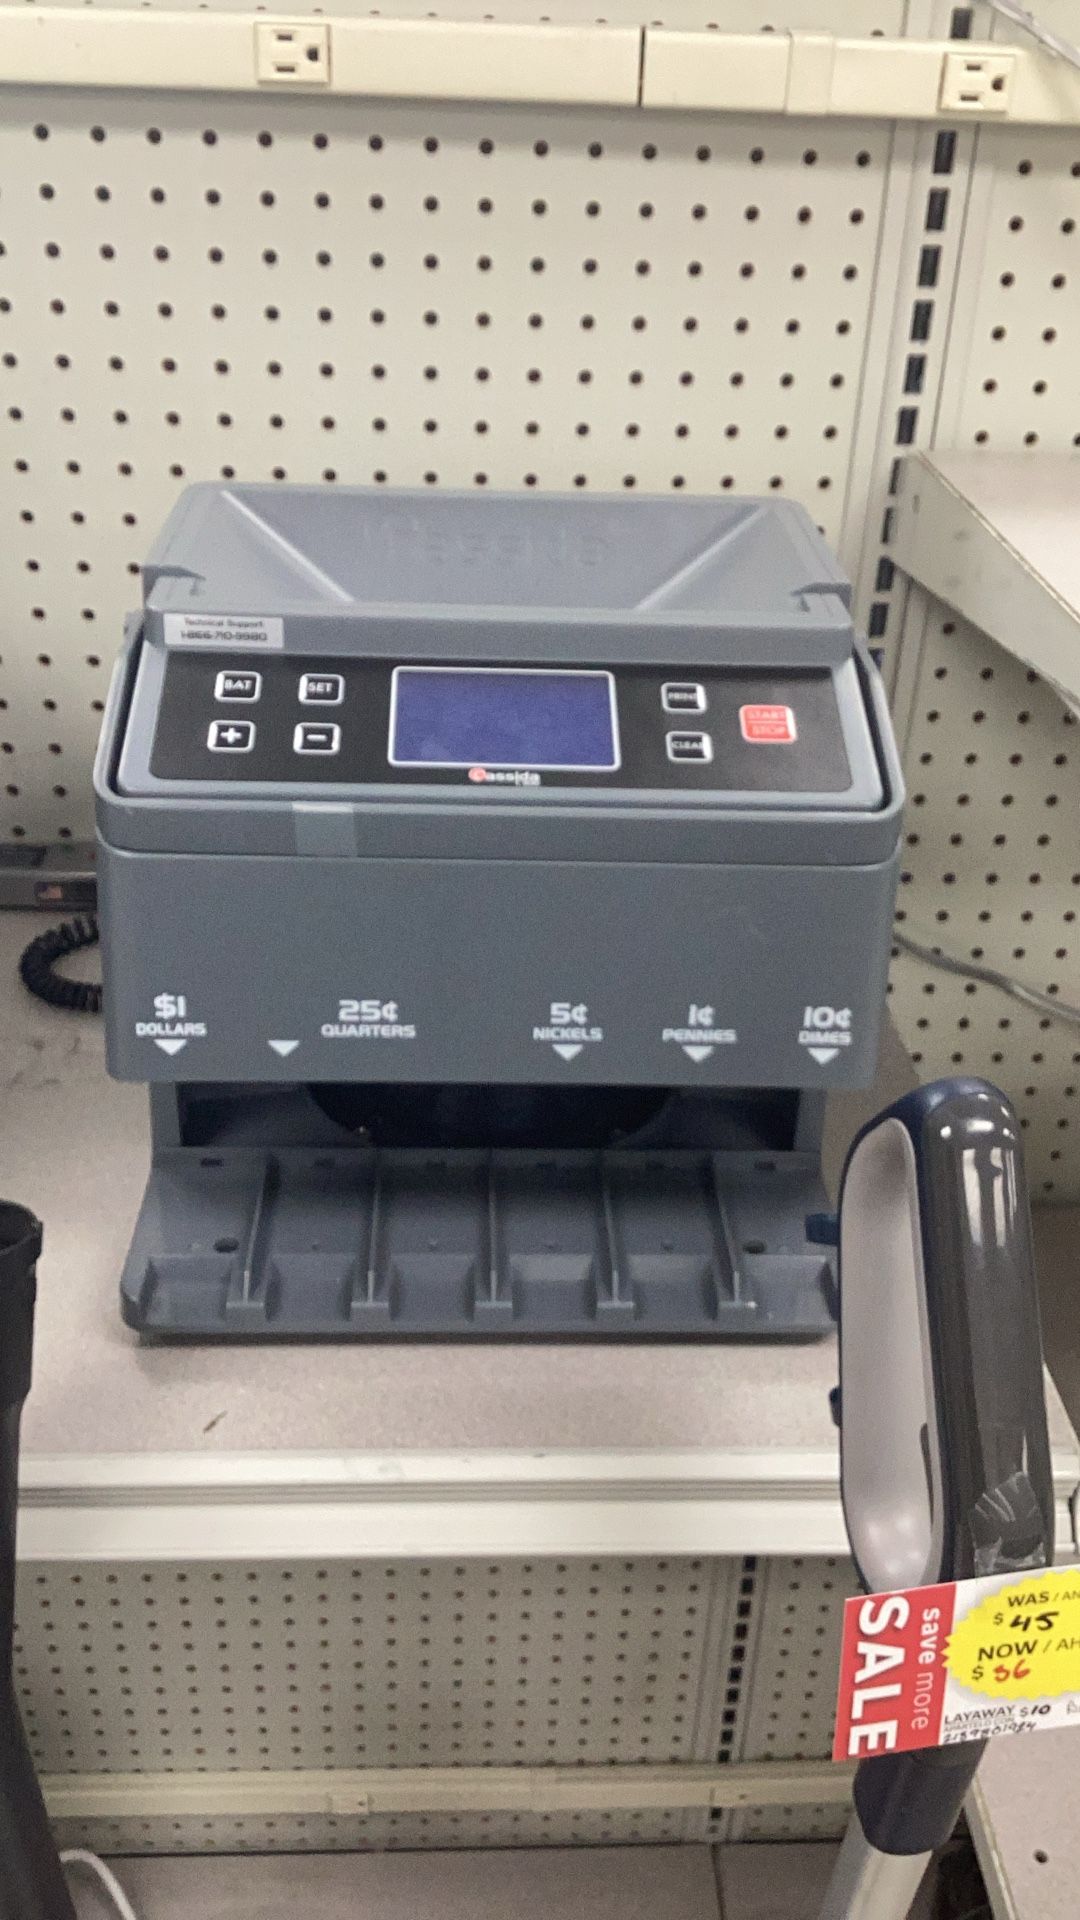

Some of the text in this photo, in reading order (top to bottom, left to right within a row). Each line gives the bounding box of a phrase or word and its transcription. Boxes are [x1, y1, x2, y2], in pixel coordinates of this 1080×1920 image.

[184, 617, 264, 629] Technical Support
[224, 679, 253, 691] BAT
[307, 682, 333, 693] SET
[751, 726, 786, 736] STOP
[154, 993, 187, 1019] $1
[338, 999, 399, 1022] 25¢
[550, 1002, 588, 1025] 5¢
[688, 1003, 715, 1027] 1¢
[803, 1006, 852, 1028] 10¢
[136, 1022, 207, 1036] DOLLARS
[321, 1023, 416, 1039] QUARTERS
[533, 1027, 603, 1041] NICKELS
[662, 1028, 737, 1043] PENNIES
[798, 1030, 851, 1046] DIMES
[1007, 1590, 1050, 1608] WAS
[1009, 1611, 1059, 1632] 45
[977, 1639, 1038, 1662] NOW
[848, 1596, 910, 1755] SALE
[911, 1607, 941, 1730] save more
[944, 1705, 1015, 1724] LAYAWAY
